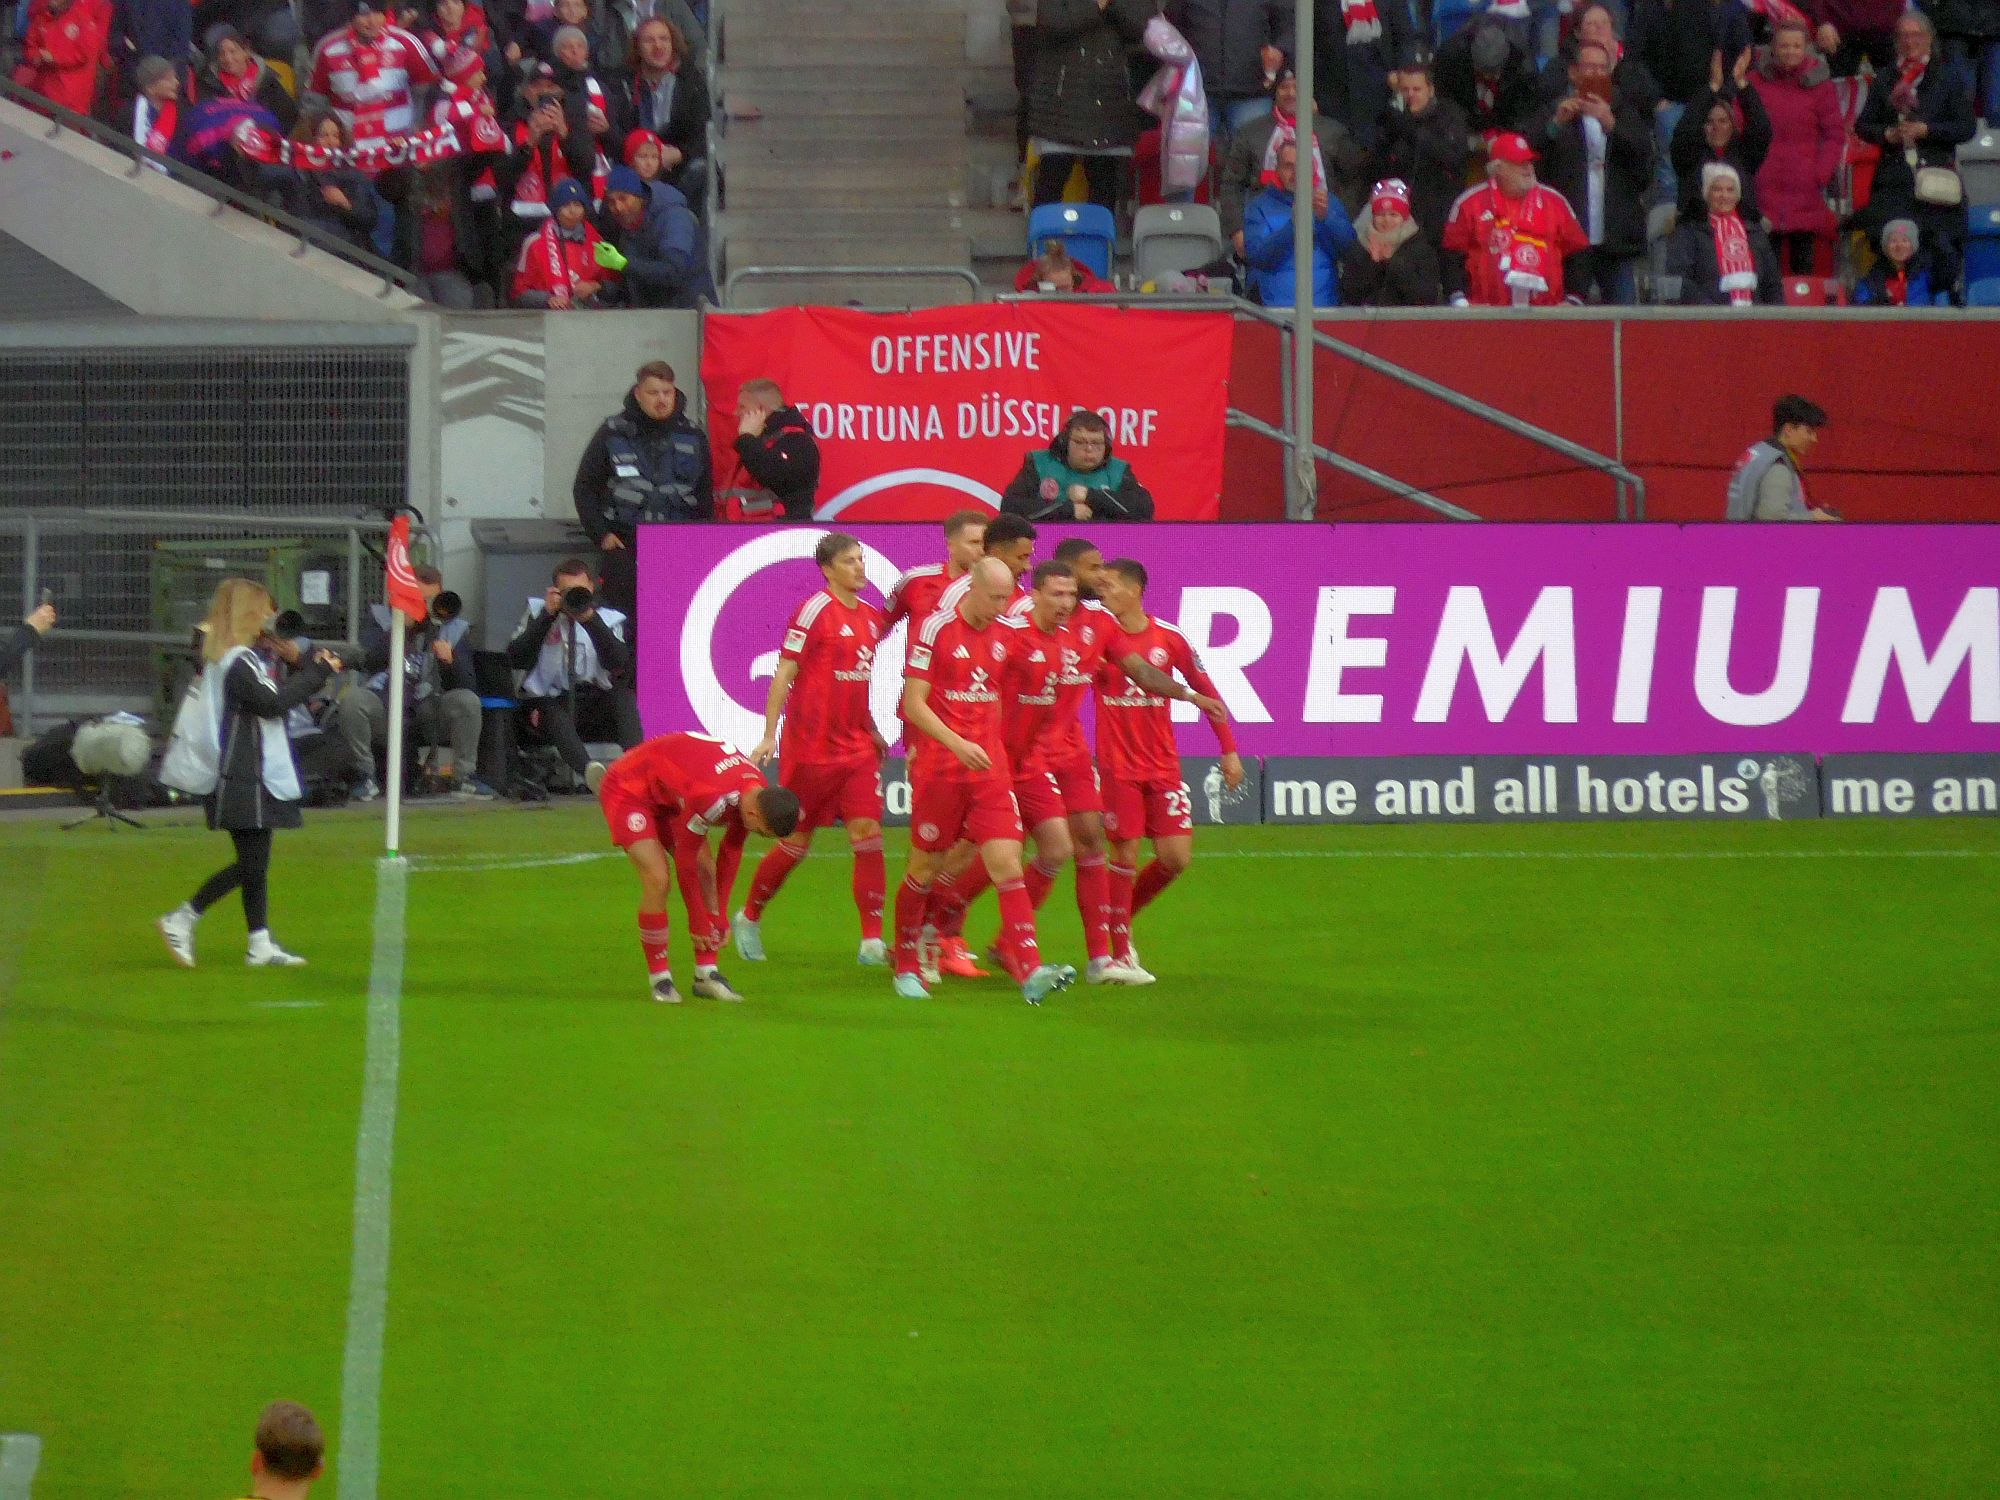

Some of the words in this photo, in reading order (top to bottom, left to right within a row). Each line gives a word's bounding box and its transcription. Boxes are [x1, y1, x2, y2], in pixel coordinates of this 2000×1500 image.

[870, 331, 1041, 374] OFFENSIVE
[957, 392, 1158, 447] DÜSSELORF
[1169, 586, 2000, 727] REMIUM
[1273, 780, 1357, 816] me
[1374, 766, 1476, 816] and
[1494, 764, 1558, 815] all
[1577, 764, 1750, 814] hotels
[1831, 777, 1915, 814] me
